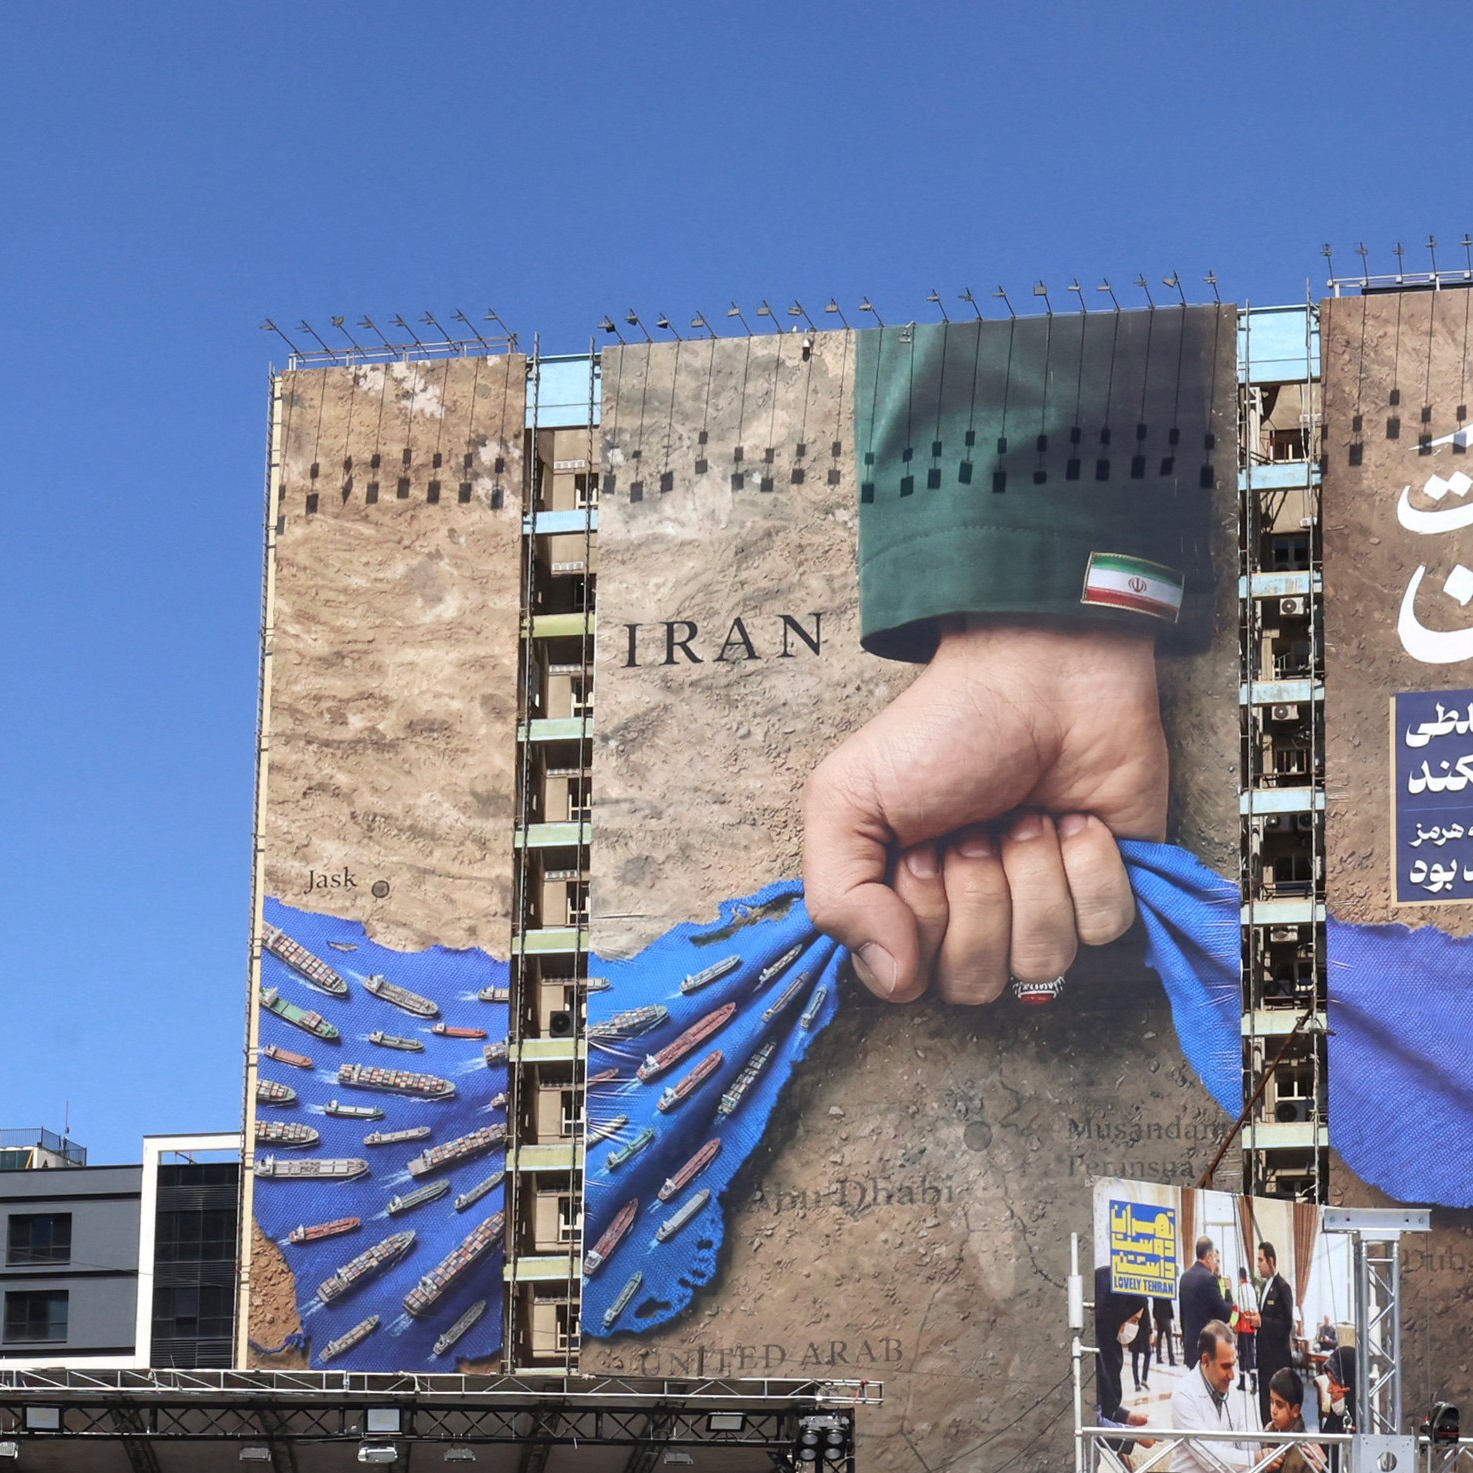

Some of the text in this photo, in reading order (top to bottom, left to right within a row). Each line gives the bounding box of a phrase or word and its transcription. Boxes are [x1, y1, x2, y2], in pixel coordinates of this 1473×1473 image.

[620, 612, 828, 668] IRAN
[1408, 823, 1464, 847] هرمز
[303, 867, 357, 895] Jask
[1408, 858, 1458, 893] بود
[1114, 1276, 1174, 1295] LOVELY TEHRAN
[640, 1338, 903, 1377] UNITED ARAB
